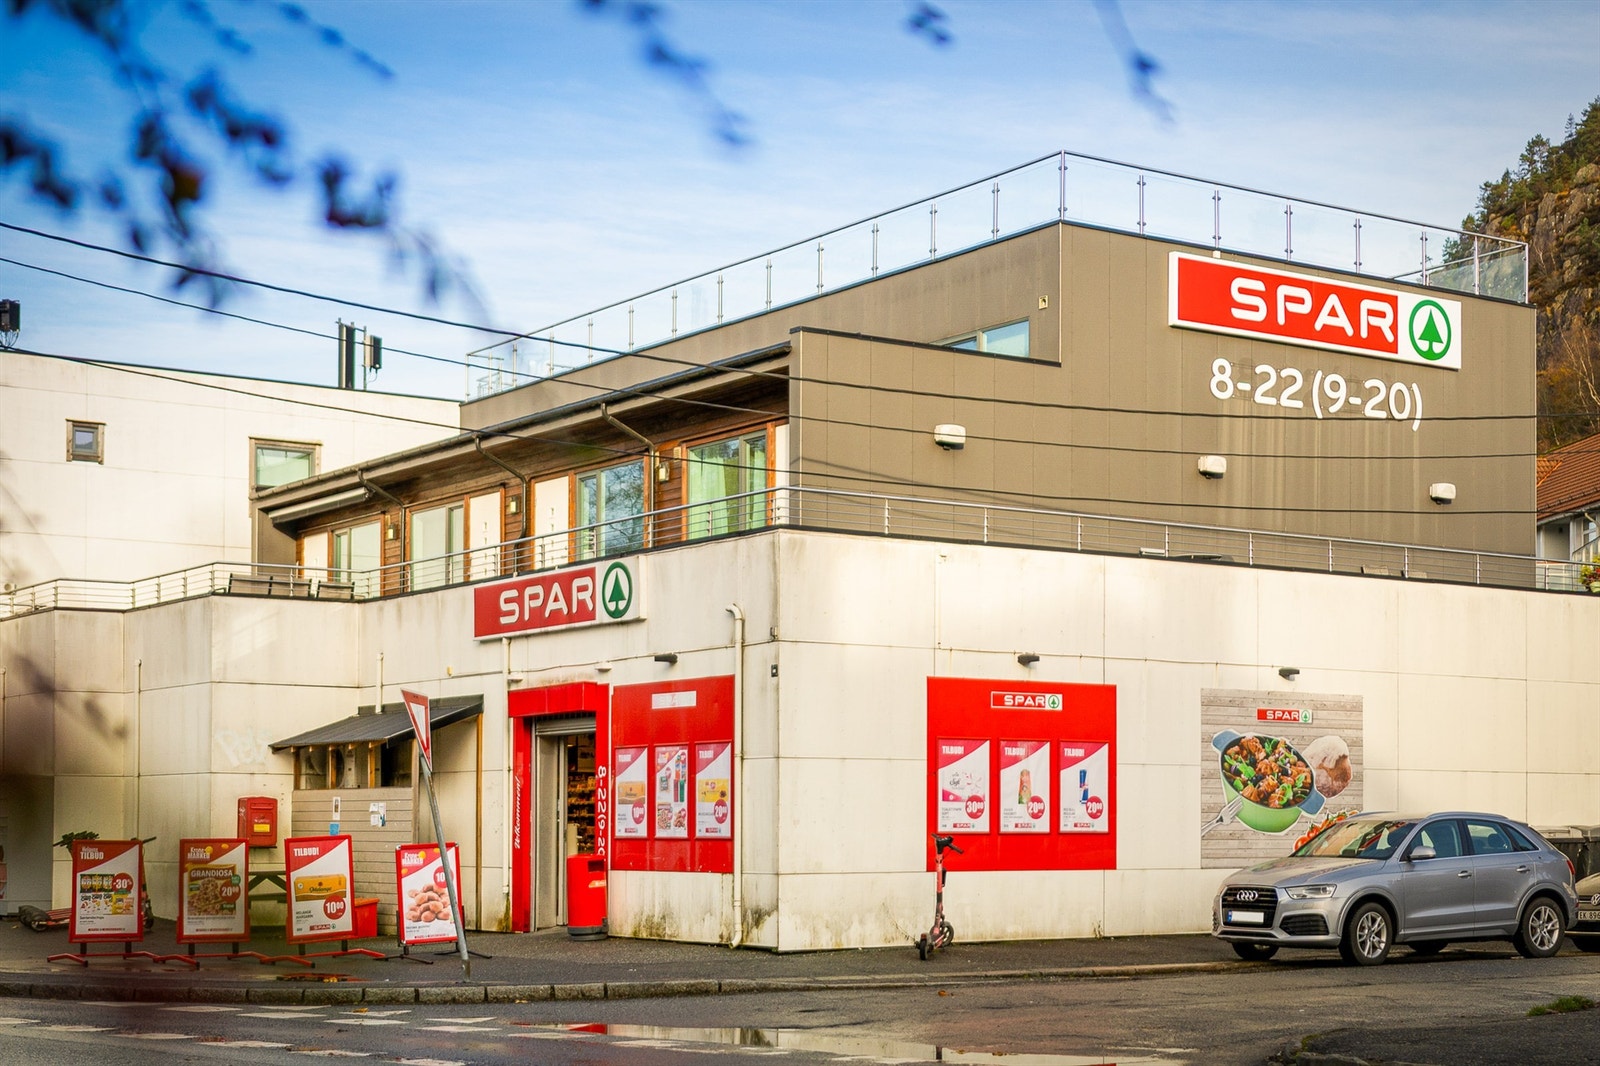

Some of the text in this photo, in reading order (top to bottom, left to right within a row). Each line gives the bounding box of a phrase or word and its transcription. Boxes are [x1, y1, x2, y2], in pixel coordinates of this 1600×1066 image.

[1230, 277, 1395, 343] SPAR
[499, 576, 594, 625] SPAR
[1004, 695, 1046, 707] SPAR
[1266, 710, 1299, 720] SPAR
[80, 851, 104, 860] TILBUD
[293, 847, 319, 856] TILBUD!
[191, 869, 233, 878] GRANDIOSA
